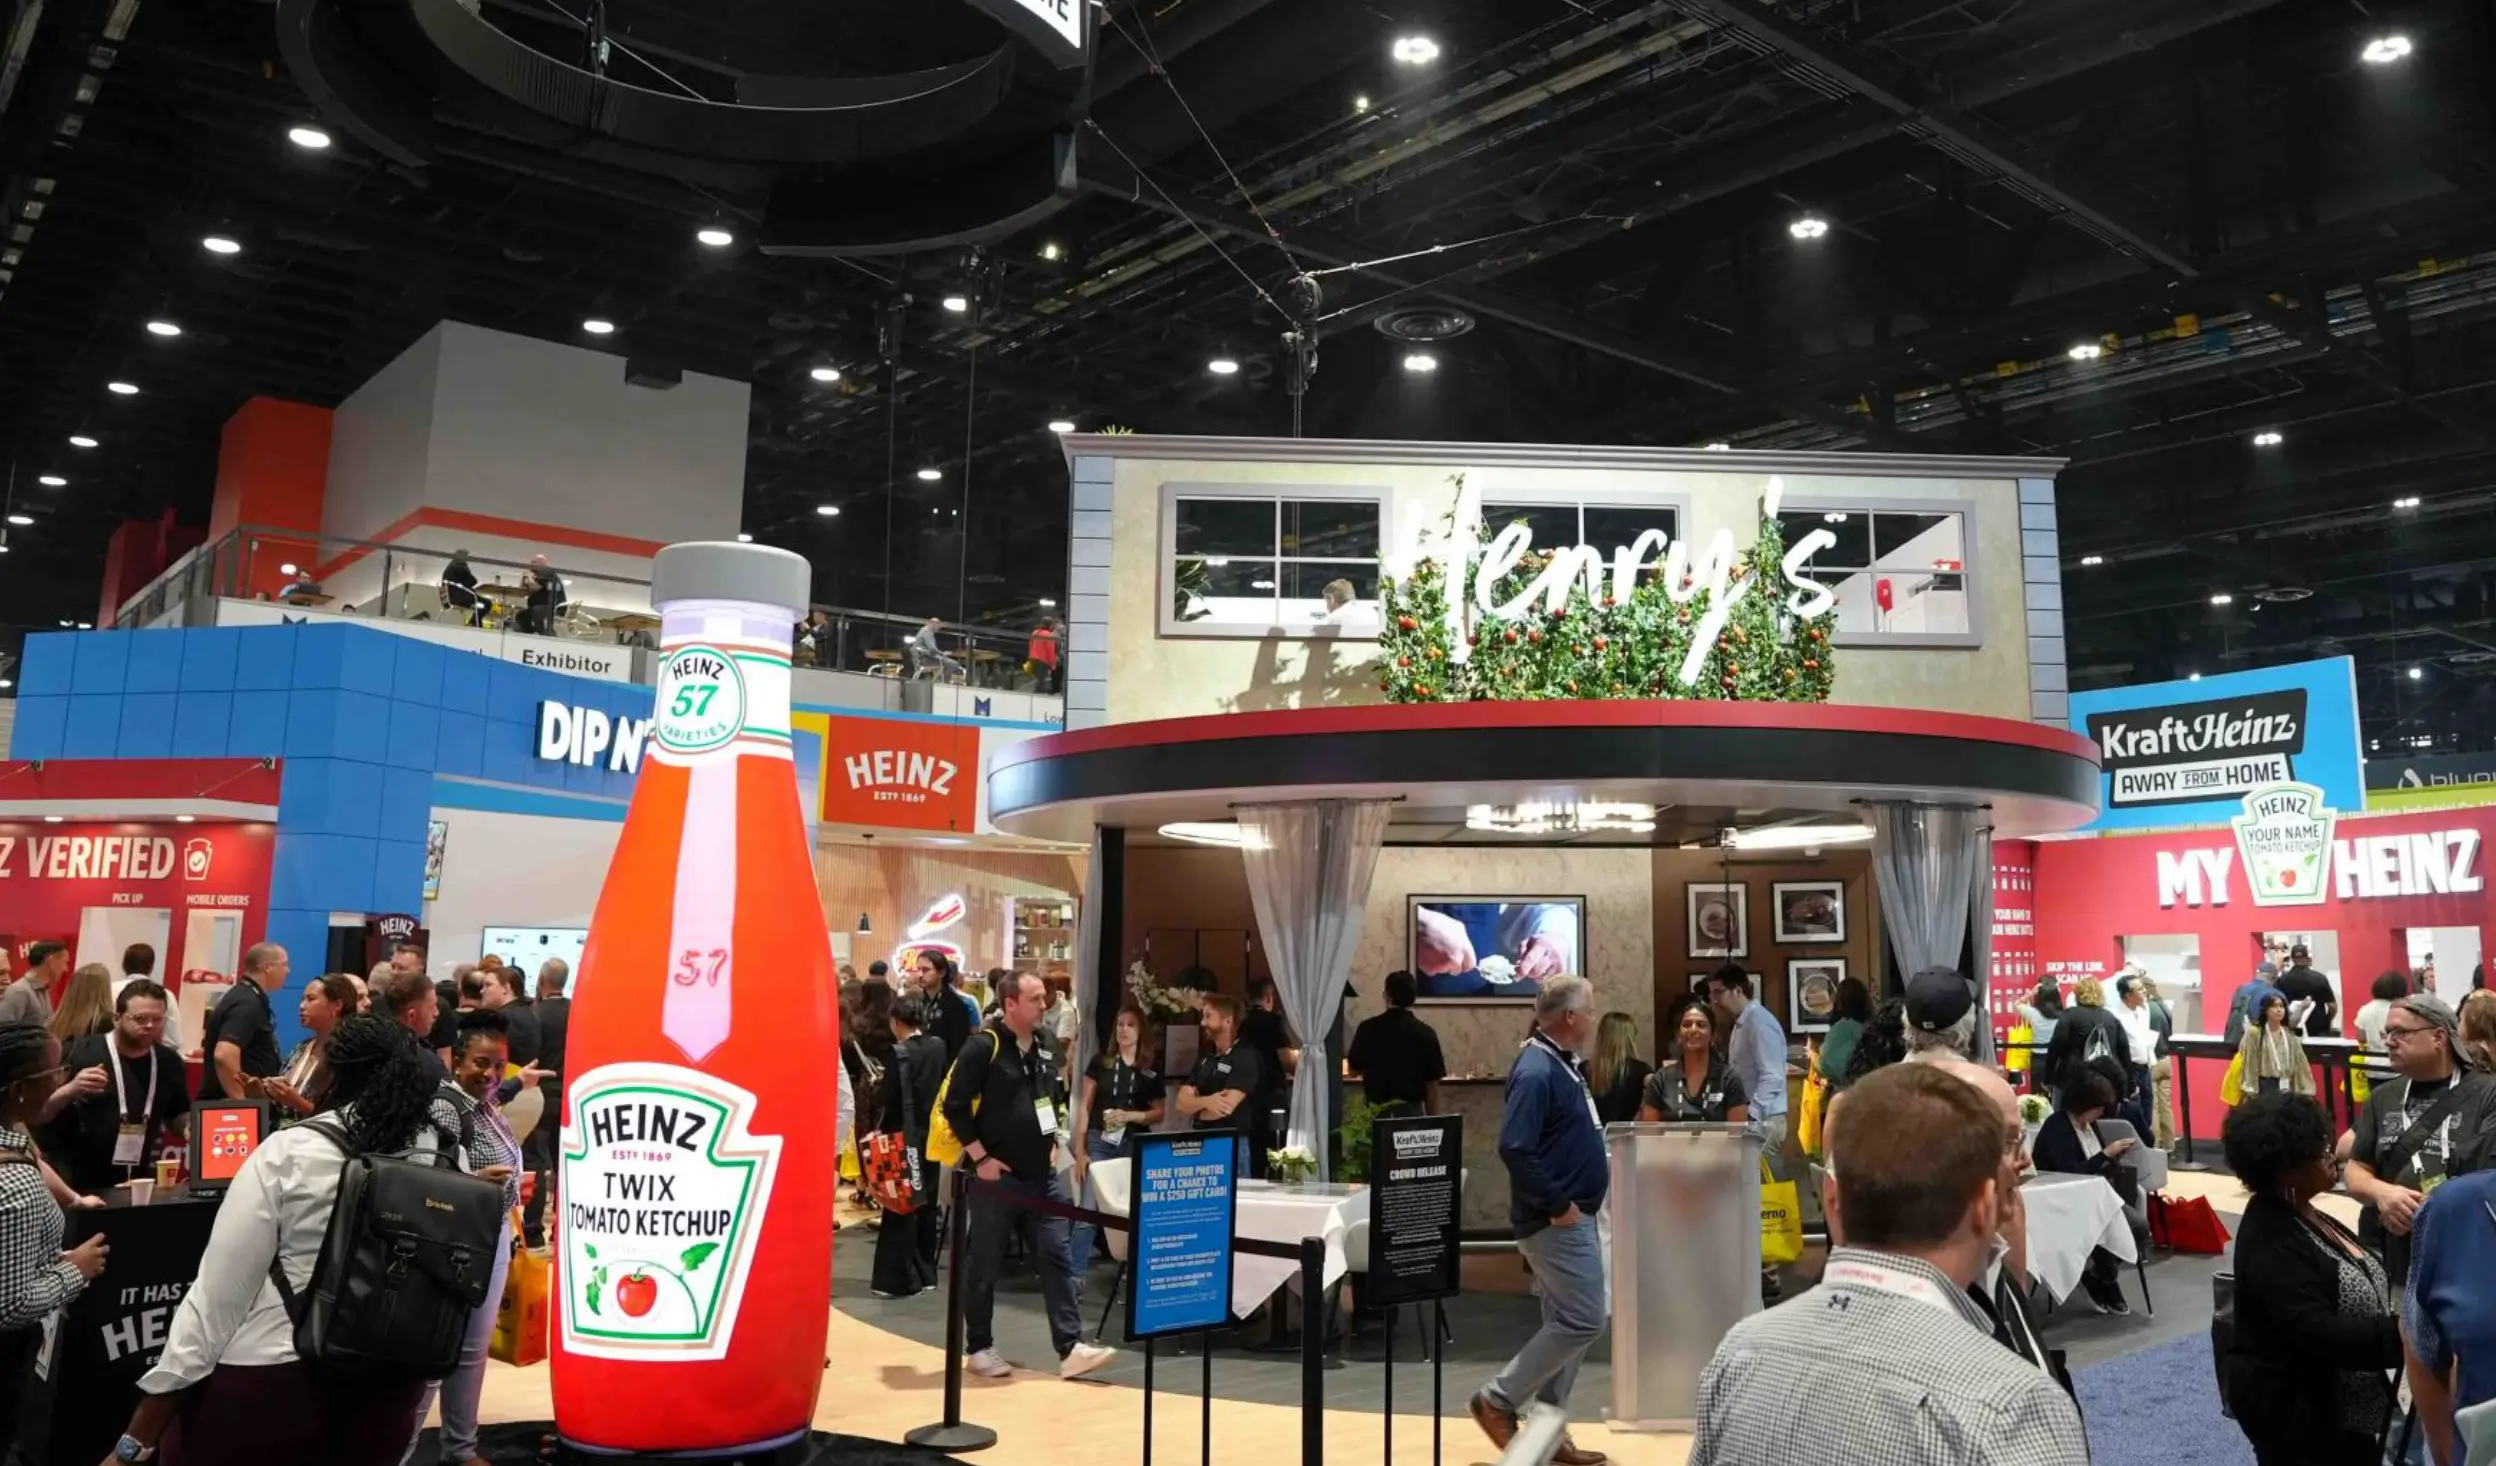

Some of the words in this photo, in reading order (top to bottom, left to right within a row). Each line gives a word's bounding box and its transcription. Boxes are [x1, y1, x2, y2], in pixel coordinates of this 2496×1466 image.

[1382, 468, 1837, 686] Henry's
[522, 648, 613, 675] Exhibitor
[672, 657, 725, 680] HEINZ
[671, 685, 719, 717] 57
[537, 699, 611, 767] DIP
[664, 722, 727, 741] VARIETIES
[844, 750, 958, 796] HEINZ
[2121, 771, 2177, 795] AWAY
[2184, 770, 2220, 786] FROM
[2226, 761, 2282, 786] HOME
[901, 792, 926, 803] 1869
[2259, 796, 2308, 818] HEINZ
[2247, 827, 2281, 842] YOUR
[2285, 824, 2320, 840] NAME
[27, 836, 176, 879] VERIFIED
[2249, 842, 2283, 855] TOMATO
[2284, 840, 2321, 853] KETCHUP
[2156, 846, 2234, 908] MY
[2331, 828, 2484, 899] HEINZ
[112, 893, 130, 904] PICK
[132, 893, 143, 904] UP
[186, 894, 215, 906] MOBILE
[217, 895, 249, 906] ORDERS
[380, 917, 415, 937] HEINZ
[674, 948, 728, 987] 57
[2045, 961, 2065, 972] SKIP
[2066, 961, 2083, 972] THE
[2055, 973, 2078, 984] SCAN
[591, 1103, 706, 1152] HEINZ
[643, 1152, 672, 1162] 1869
[1146, 1167, 1173, 1180] SHARE
[1173, 1166, 1194, 1178] YOUR
[1195, 1164, 1225, 1176] PHOTOS
[1153, 1179, 1169, 1191] FOR
[1169, 1178, 1176, 1190] A
[1177, 1176, 1207, 1189] CHANCE
[1208, 1175, 1218, 1186] TO
[1389, 1168, 1416, 1180] CROWD
[1417, 1165, 1447, 1178] RELEASE
[604, 1172, 675, 1202] TWIX
[1142, 1191, 1158, 1203] WIN
[1159, 1191, 1166, 1202] A
[570, 1202, 630, 1235] TOMATO
[636, 1209, 732, 1237] KETCHUP
[120, 1287, 139, 1305] IT
[143, 1283, 181, 1303] HAS
